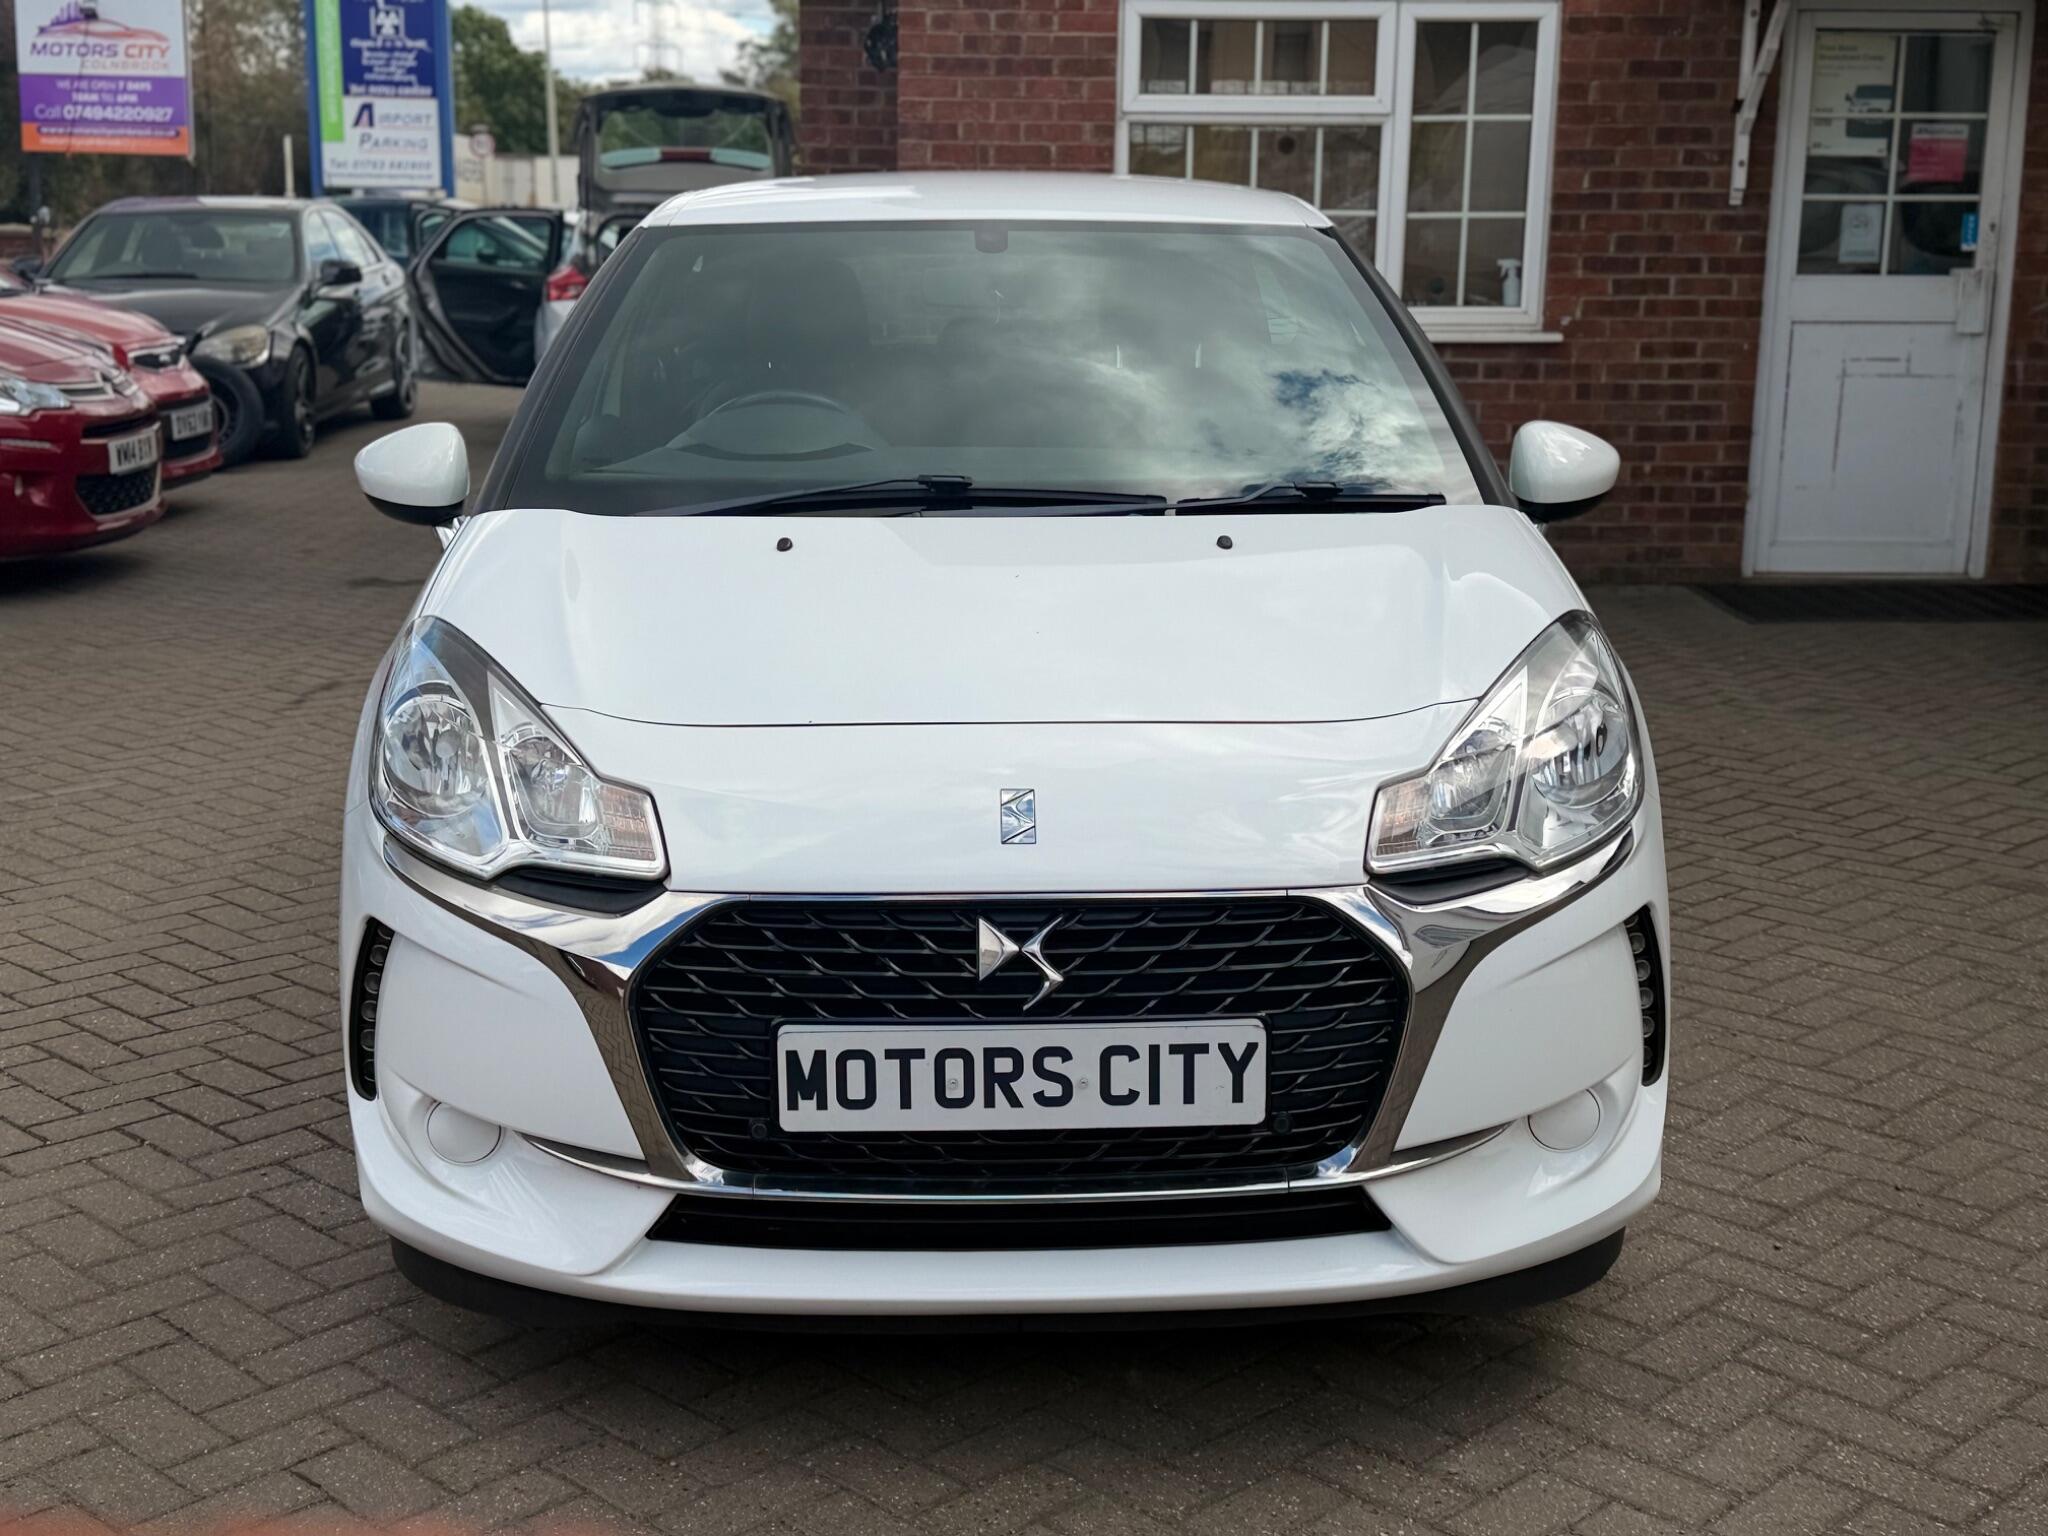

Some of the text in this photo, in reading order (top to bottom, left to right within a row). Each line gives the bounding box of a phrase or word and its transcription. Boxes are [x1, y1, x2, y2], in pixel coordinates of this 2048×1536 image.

[30, 43, 171, 60] MOTORS CITY
[82, 60, 169, 71] COLNBROOK
[35, 104, 61, 119] Call
[353, 103, 432, 128] AIRPORT
[359, 132, 429, 150] PARKING
[785, 1042, 1259, 1111] MOTORS CITY
